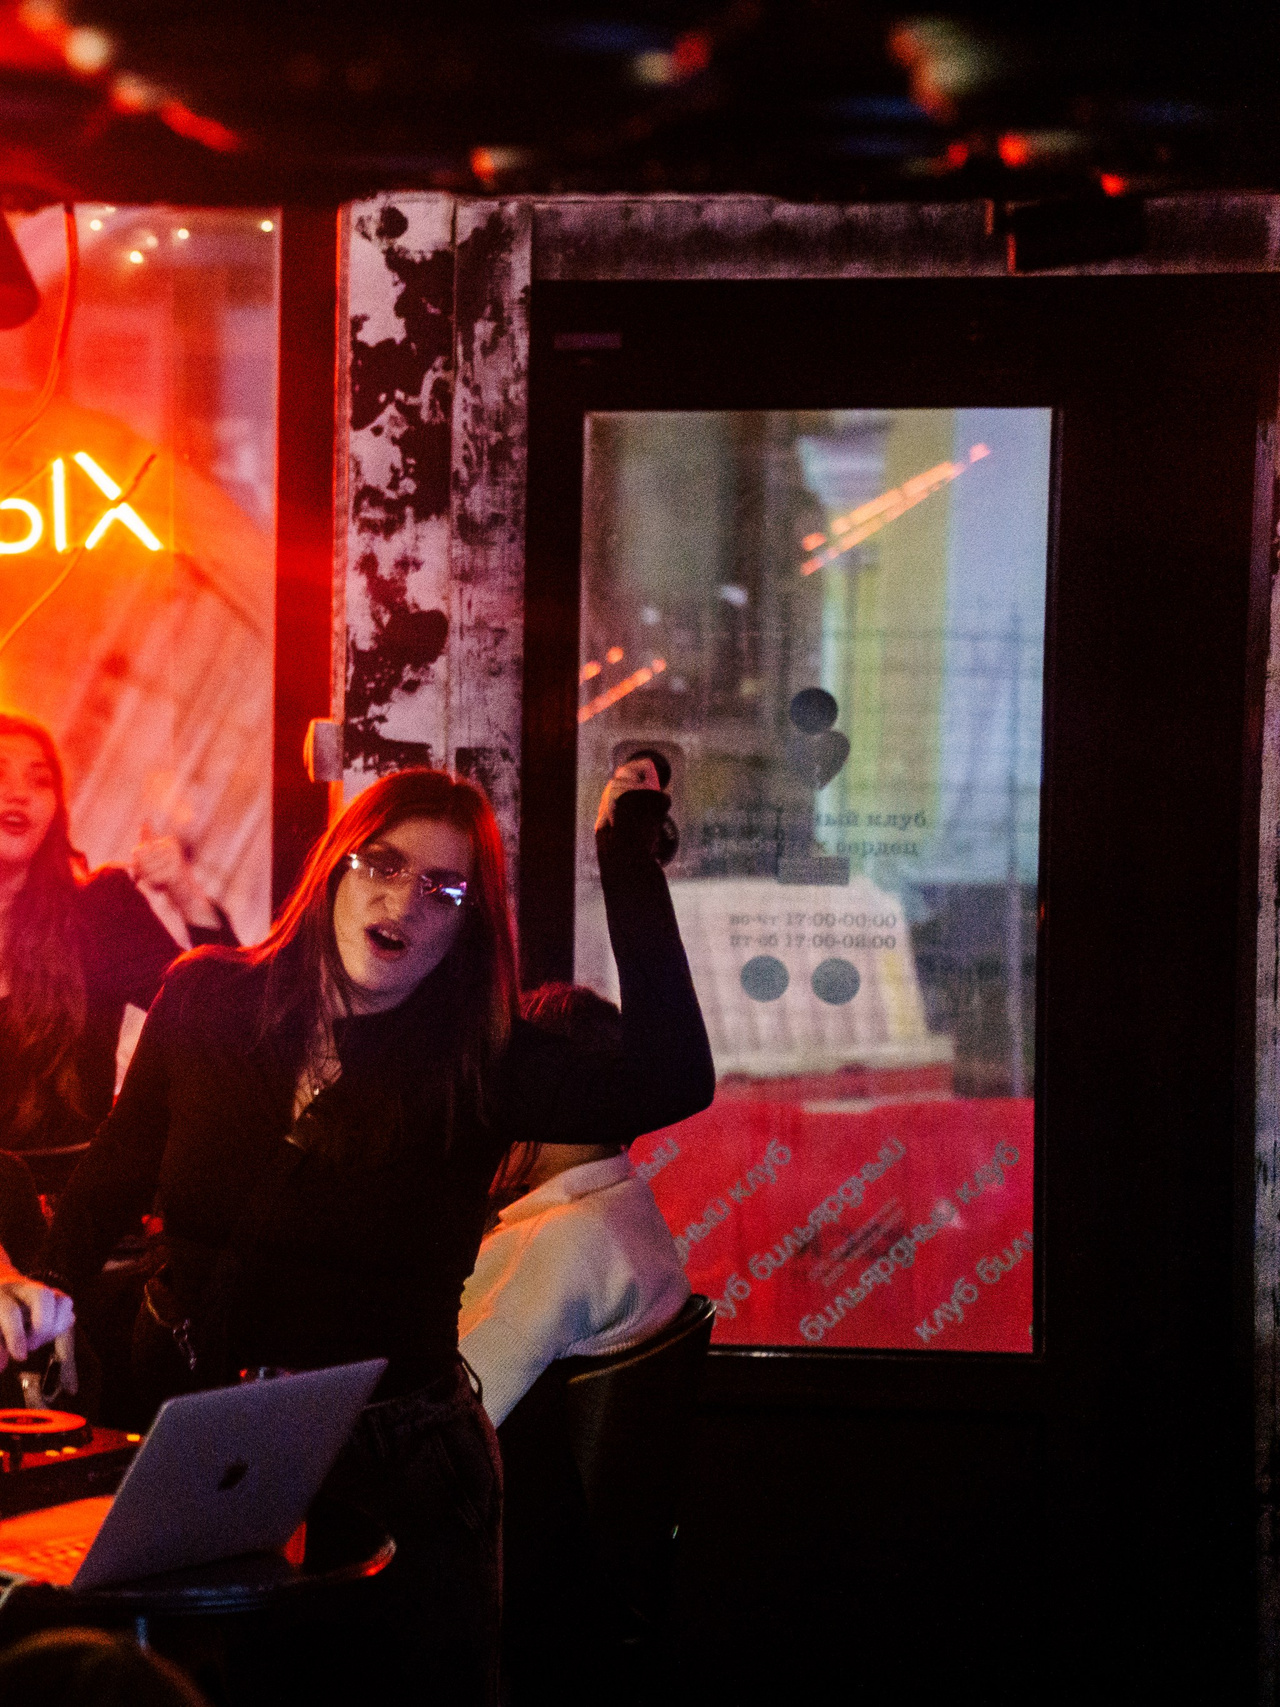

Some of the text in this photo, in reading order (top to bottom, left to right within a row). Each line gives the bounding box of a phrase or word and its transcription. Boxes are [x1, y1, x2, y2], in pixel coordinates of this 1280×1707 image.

[729, 1139, 791, 1203] клуб
[956, 1140, 1020, 1204] клуб
[748, 1139, 906, 1280] бильярдный
[915, 1277, 979, 1343] клуб
